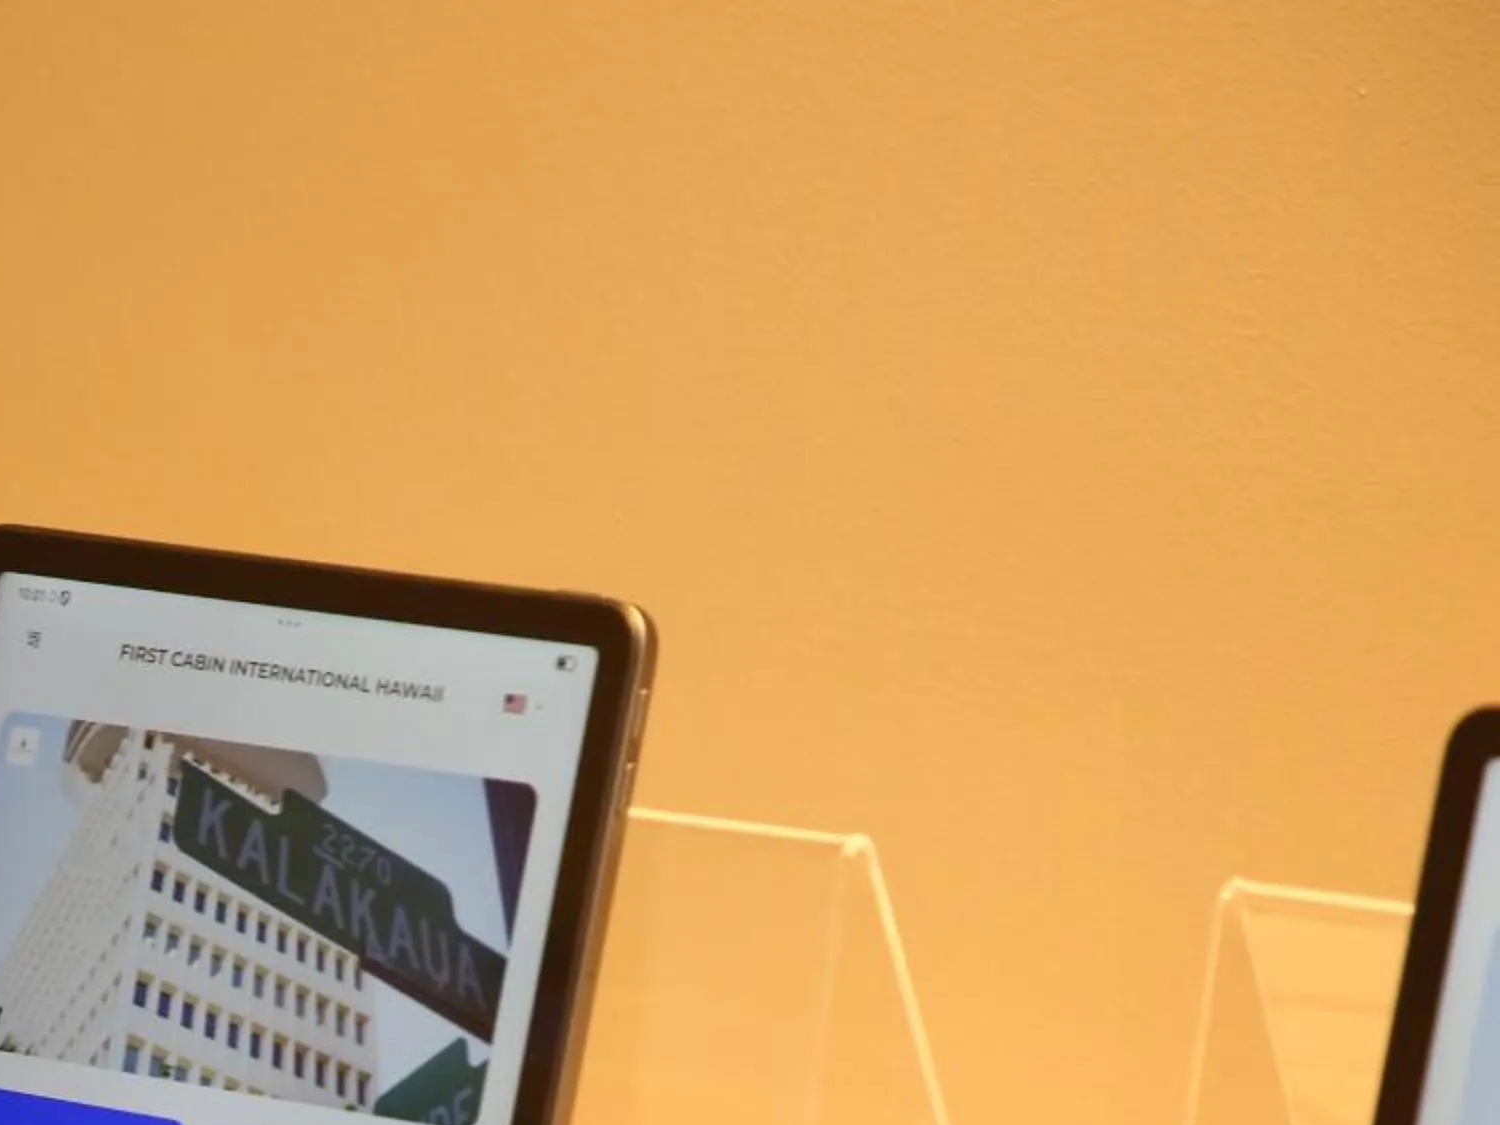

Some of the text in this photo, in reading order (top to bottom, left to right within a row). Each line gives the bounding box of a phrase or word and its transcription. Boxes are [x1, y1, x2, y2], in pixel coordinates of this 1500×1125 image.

[119, 643, 446, 702] FIRST CABIN INTERNATIONAL HAWAII
[321, 822, 392, 887] 2270
